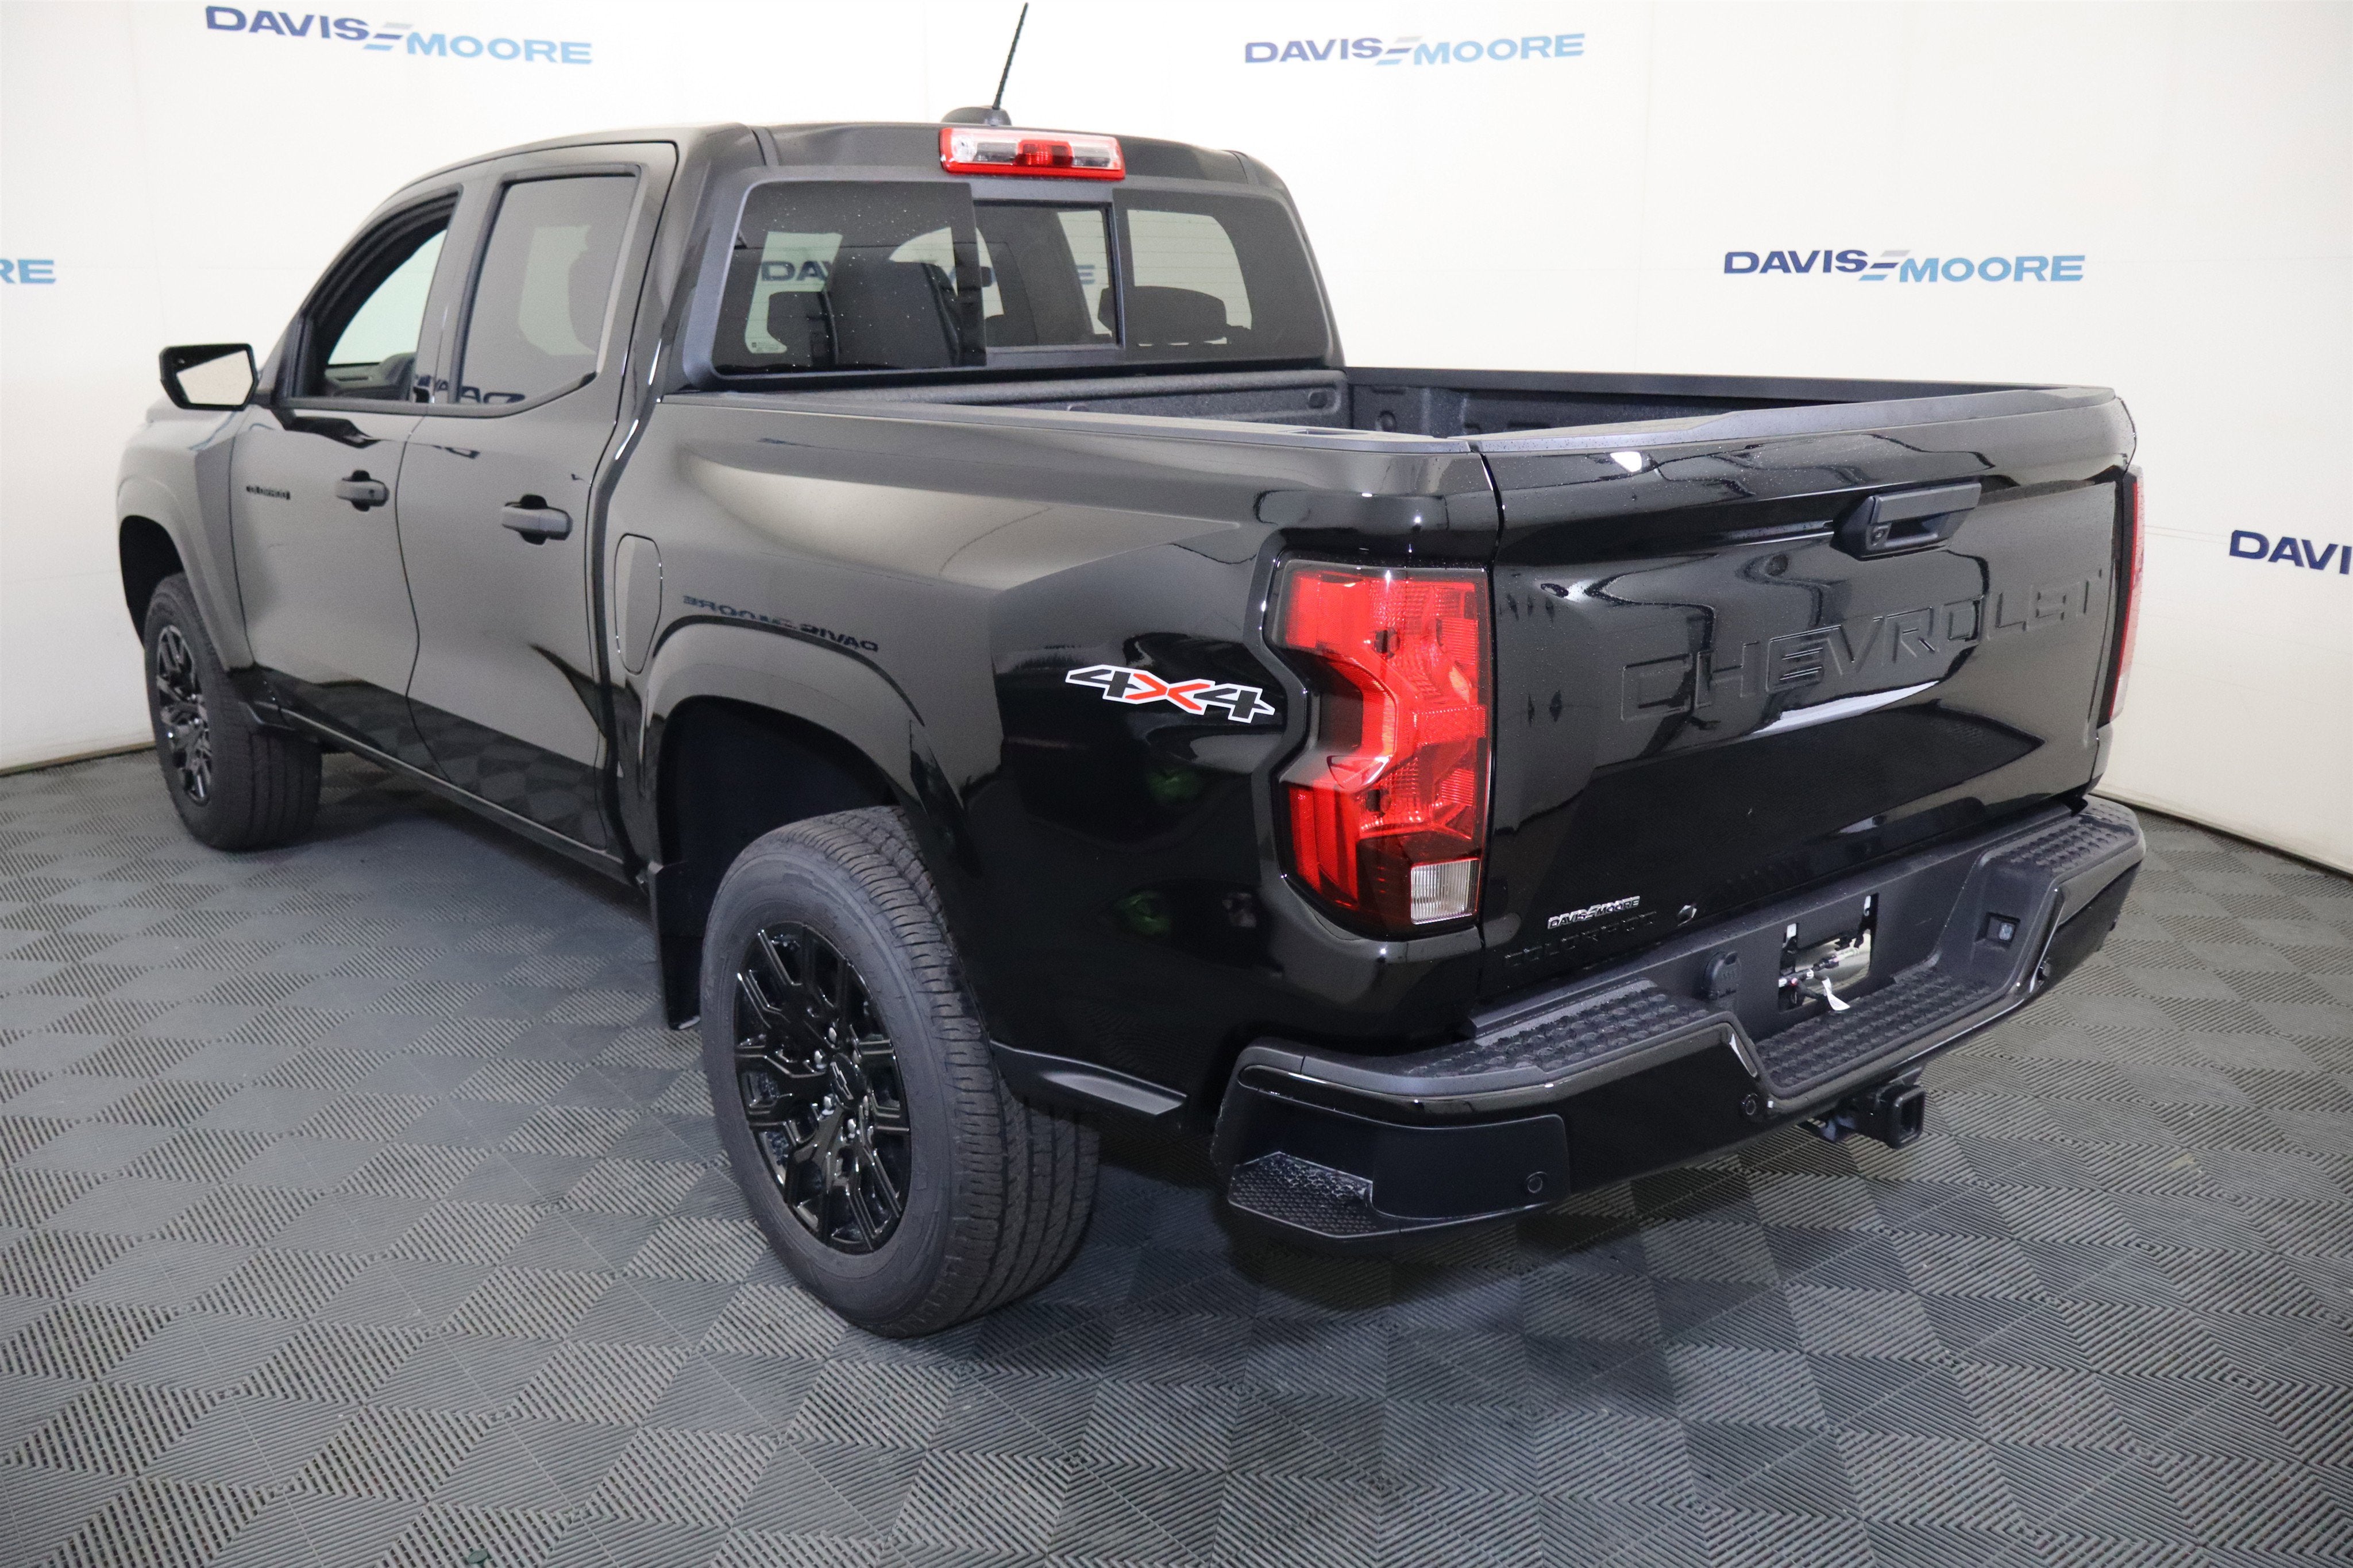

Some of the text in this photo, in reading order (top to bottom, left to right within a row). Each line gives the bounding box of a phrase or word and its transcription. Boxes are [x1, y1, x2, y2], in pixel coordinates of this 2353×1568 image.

[205, 5, 593, 65] DAVIS MOORE
[1244, 33, 1586, 66] DAVIS MOORE
[1723, 249, 2086, 283] DAVIS MOORE
[1621, 569, 2103, 721] CHEVROLET
[1547, 895, 1641, 929] DAVIS MOORE
